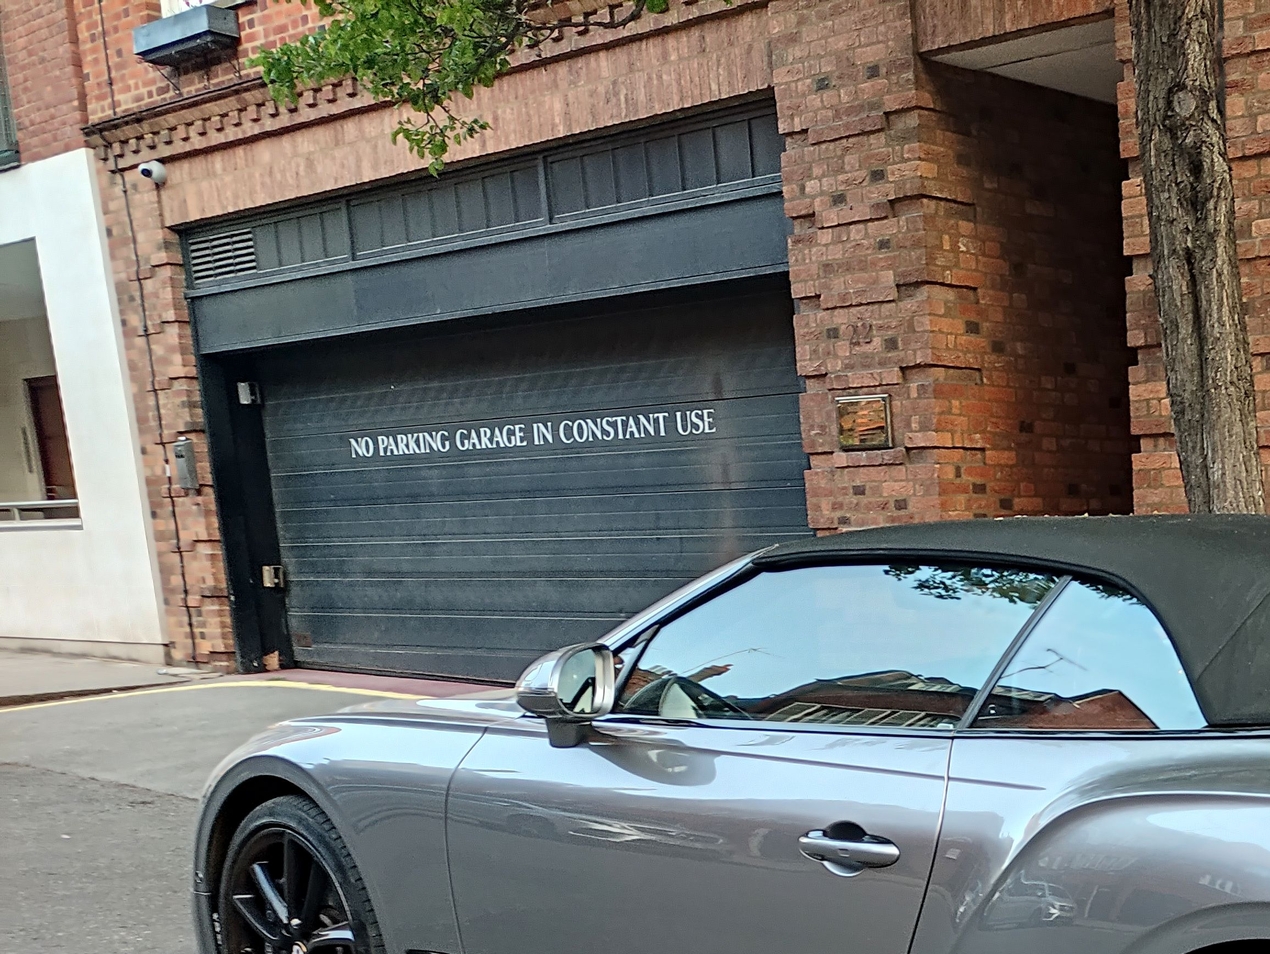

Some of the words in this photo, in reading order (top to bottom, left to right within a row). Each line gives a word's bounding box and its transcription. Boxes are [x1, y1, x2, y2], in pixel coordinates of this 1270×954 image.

[349, 436, 374, 459] NO
[377, 430, 450, 457] PARKING
[455, 423, 528, 451] GARAGE
[532, 422, 554, 445] IN
[558, 412, 669, 444] CONSTANT
[675, 408, 717, 436] USE
